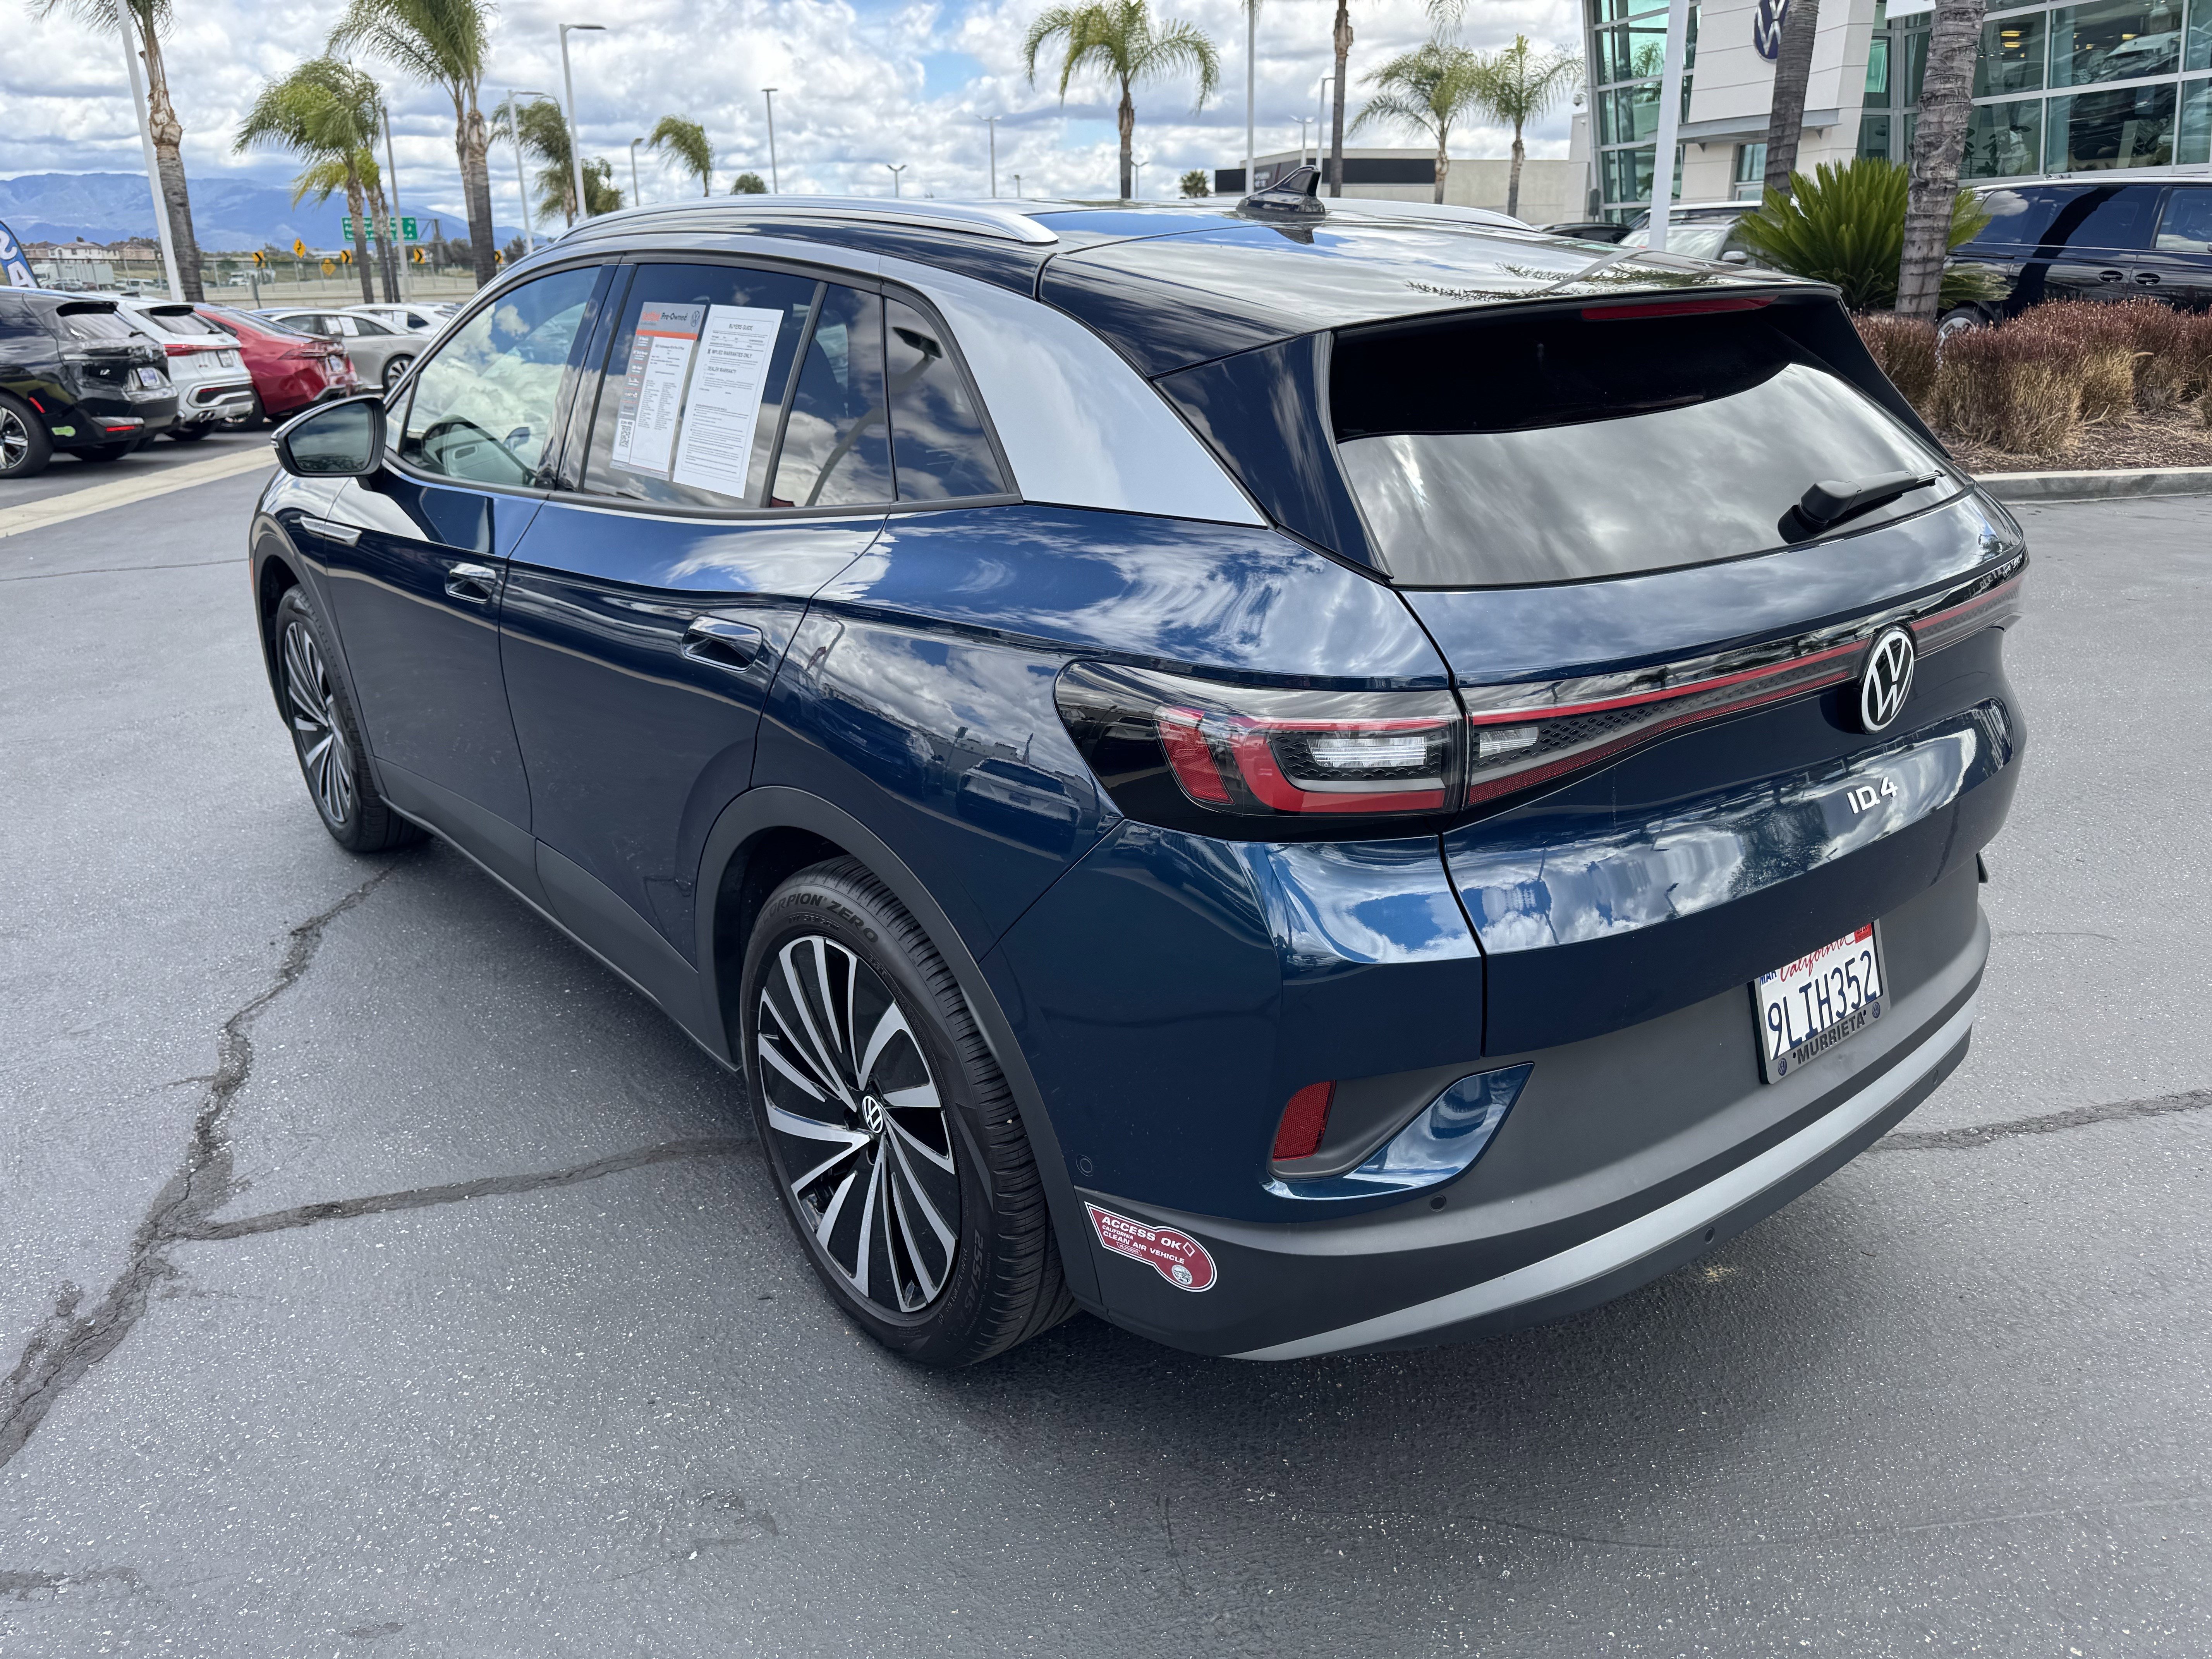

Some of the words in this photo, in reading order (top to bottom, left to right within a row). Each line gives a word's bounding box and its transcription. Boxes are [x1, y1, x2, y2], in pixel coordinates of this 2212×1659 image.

[661, 312, 688, 321] Pre-Owned
[804, 915, 840, 931] SEASON
[826, 900, 878, 943] ZERO
[1768, 950, 1877, 1060] 9LIH352
[1797, 1012, 1865, 1065] MURRIETA
[1102, 1225, 1133, 1240] CALIFORNIA
[1102, 1216, 1156, 1241] ACCESS
[1161, 1237, 1182, 1250] OK
[1103, 1231, 1130, 1245] CLEAN
[1132, 1242, 1147, 1251] AIR
[1150, 1247, 1185, 1264] VEHICLE
